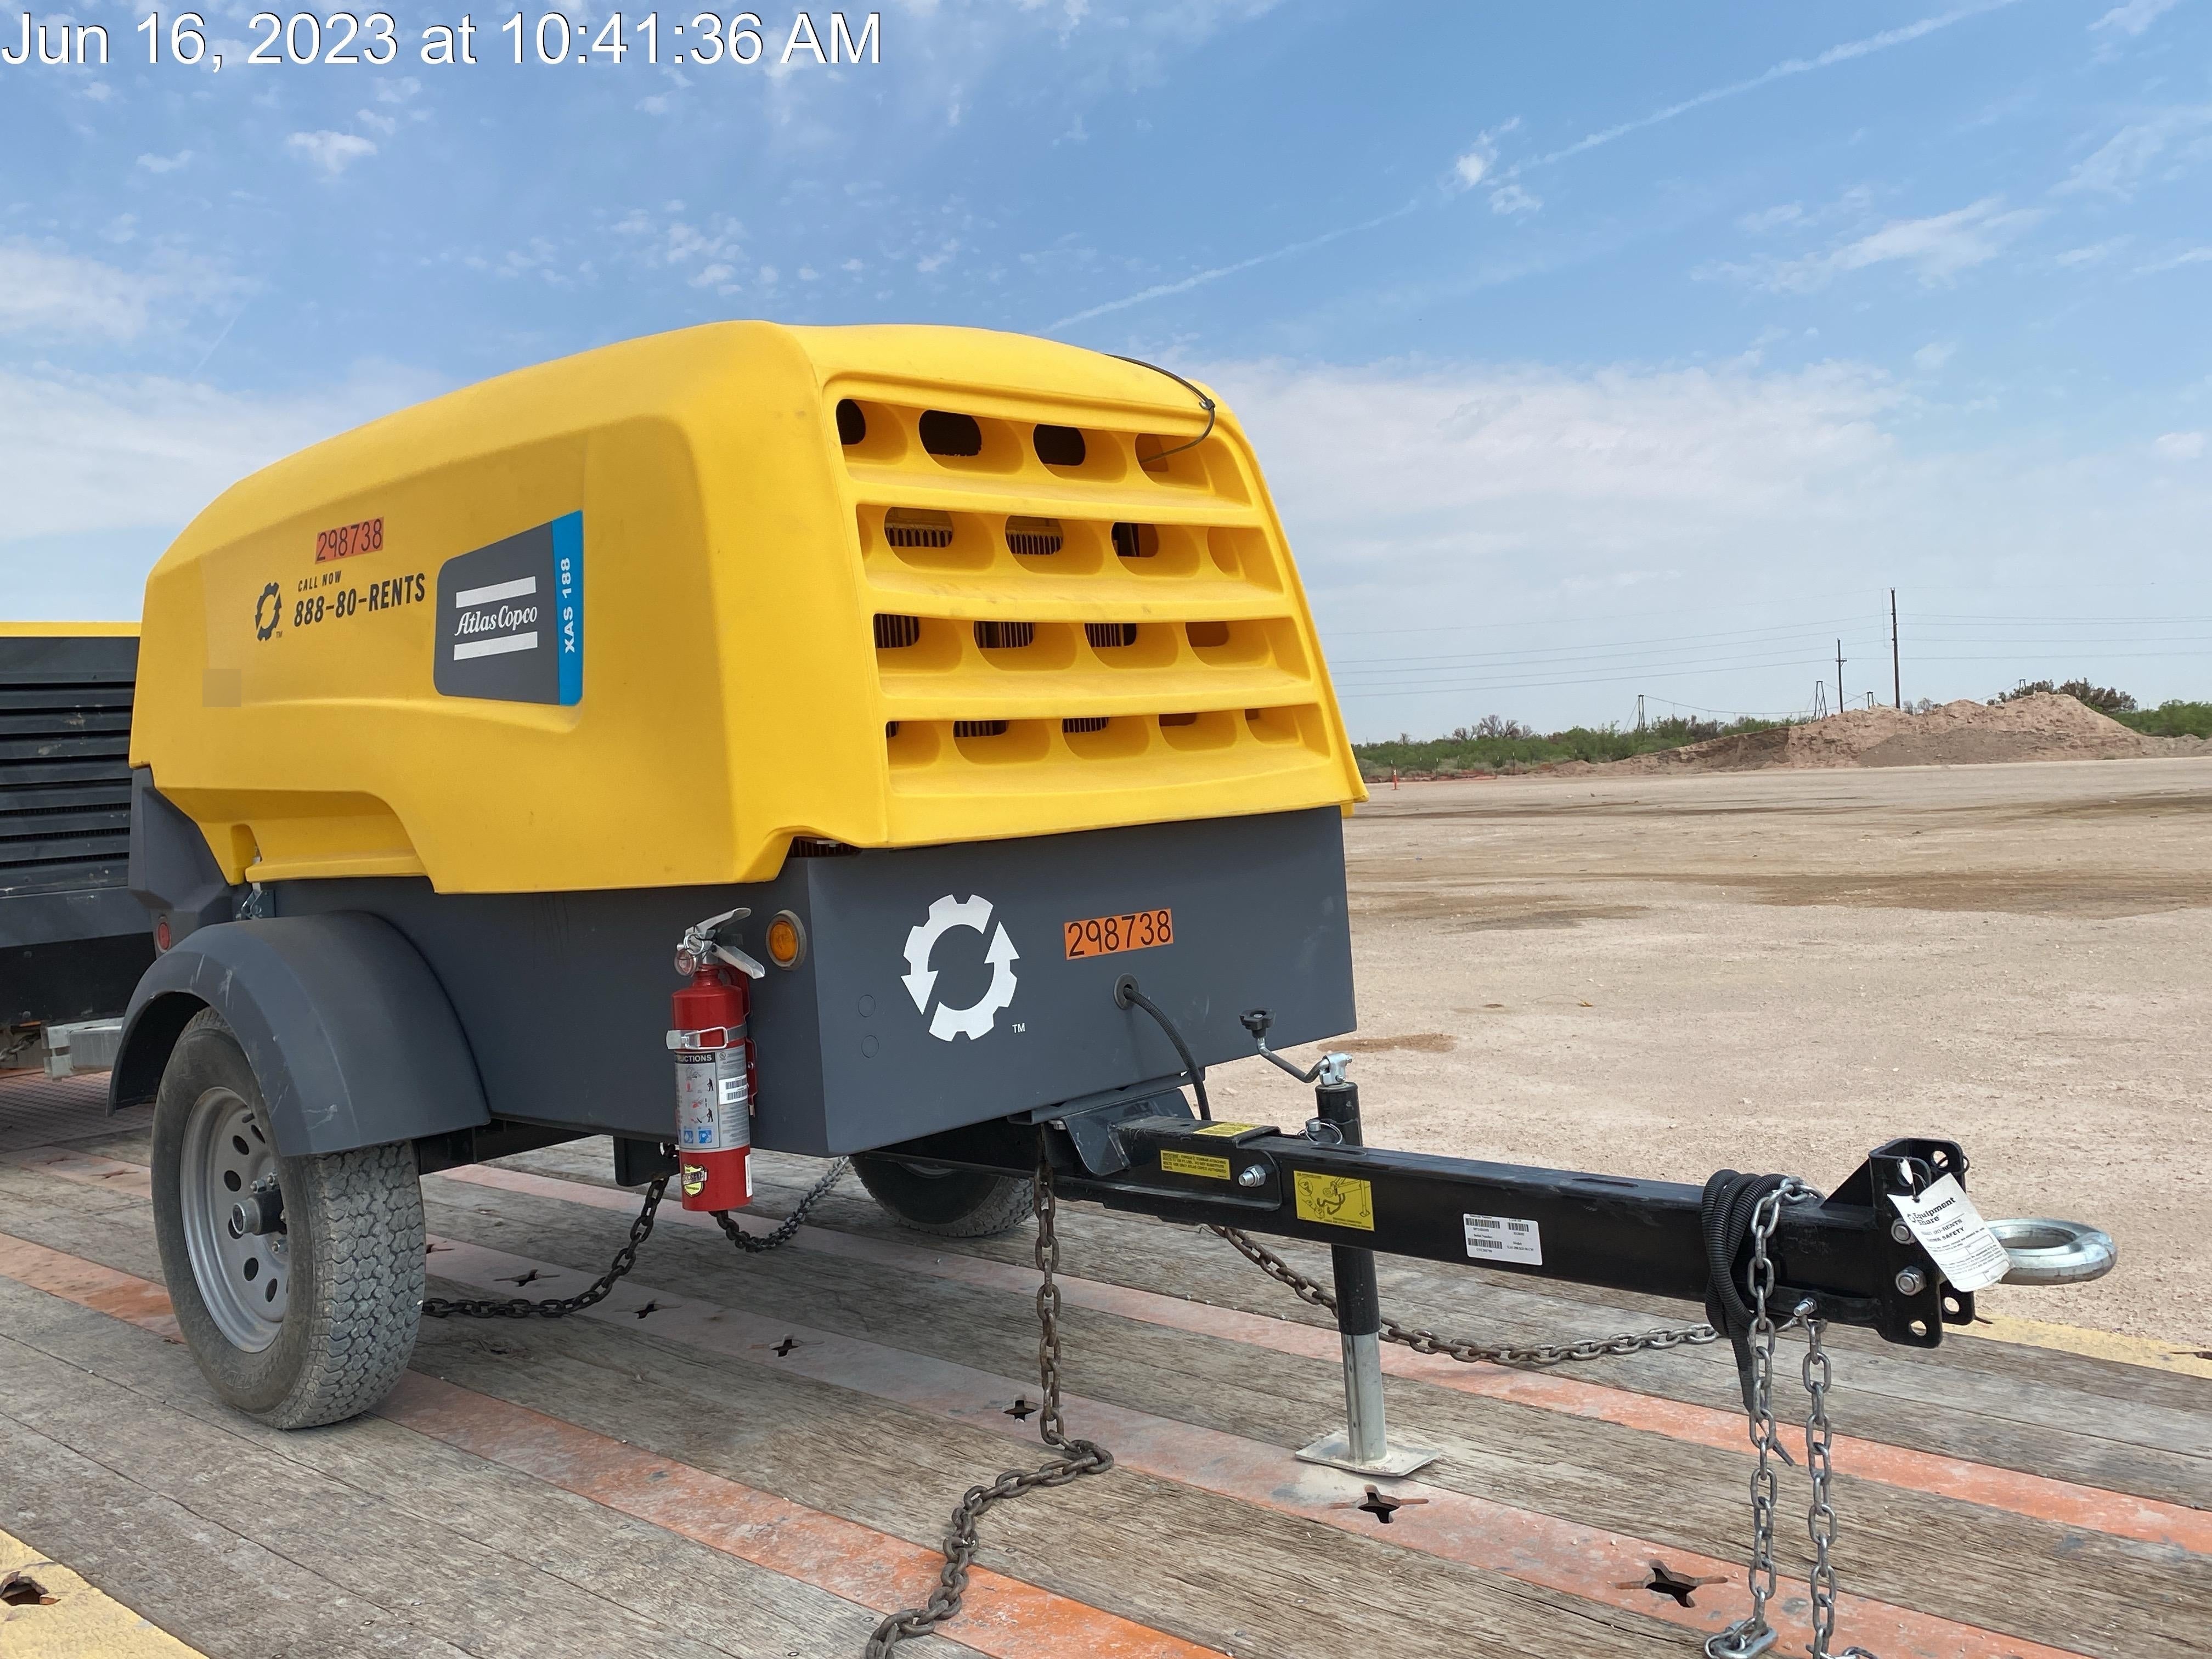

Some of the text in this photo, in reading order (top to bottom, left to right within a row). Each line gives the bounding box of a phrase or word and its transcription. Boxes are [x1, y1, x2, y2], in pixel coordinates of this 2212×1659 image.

[316, 518, 382, 561] 298738
[298, 571, 342, 592] CALL NOW
[294, 573, 425, 627] 888-80-RENTS
[561, 557, 575, 653] XAS 188
[454, 605, 538, 636] Atlas Copco
[1068, 910, 1171, 957] 298738
[1012, 1023, 1025, 1033] TM
[1912, 1197, 1956, 1220] Equipment
[1917, 1216, 1940, 1225] Share
[1942, 1226, 1964, 1240] SAFETY
